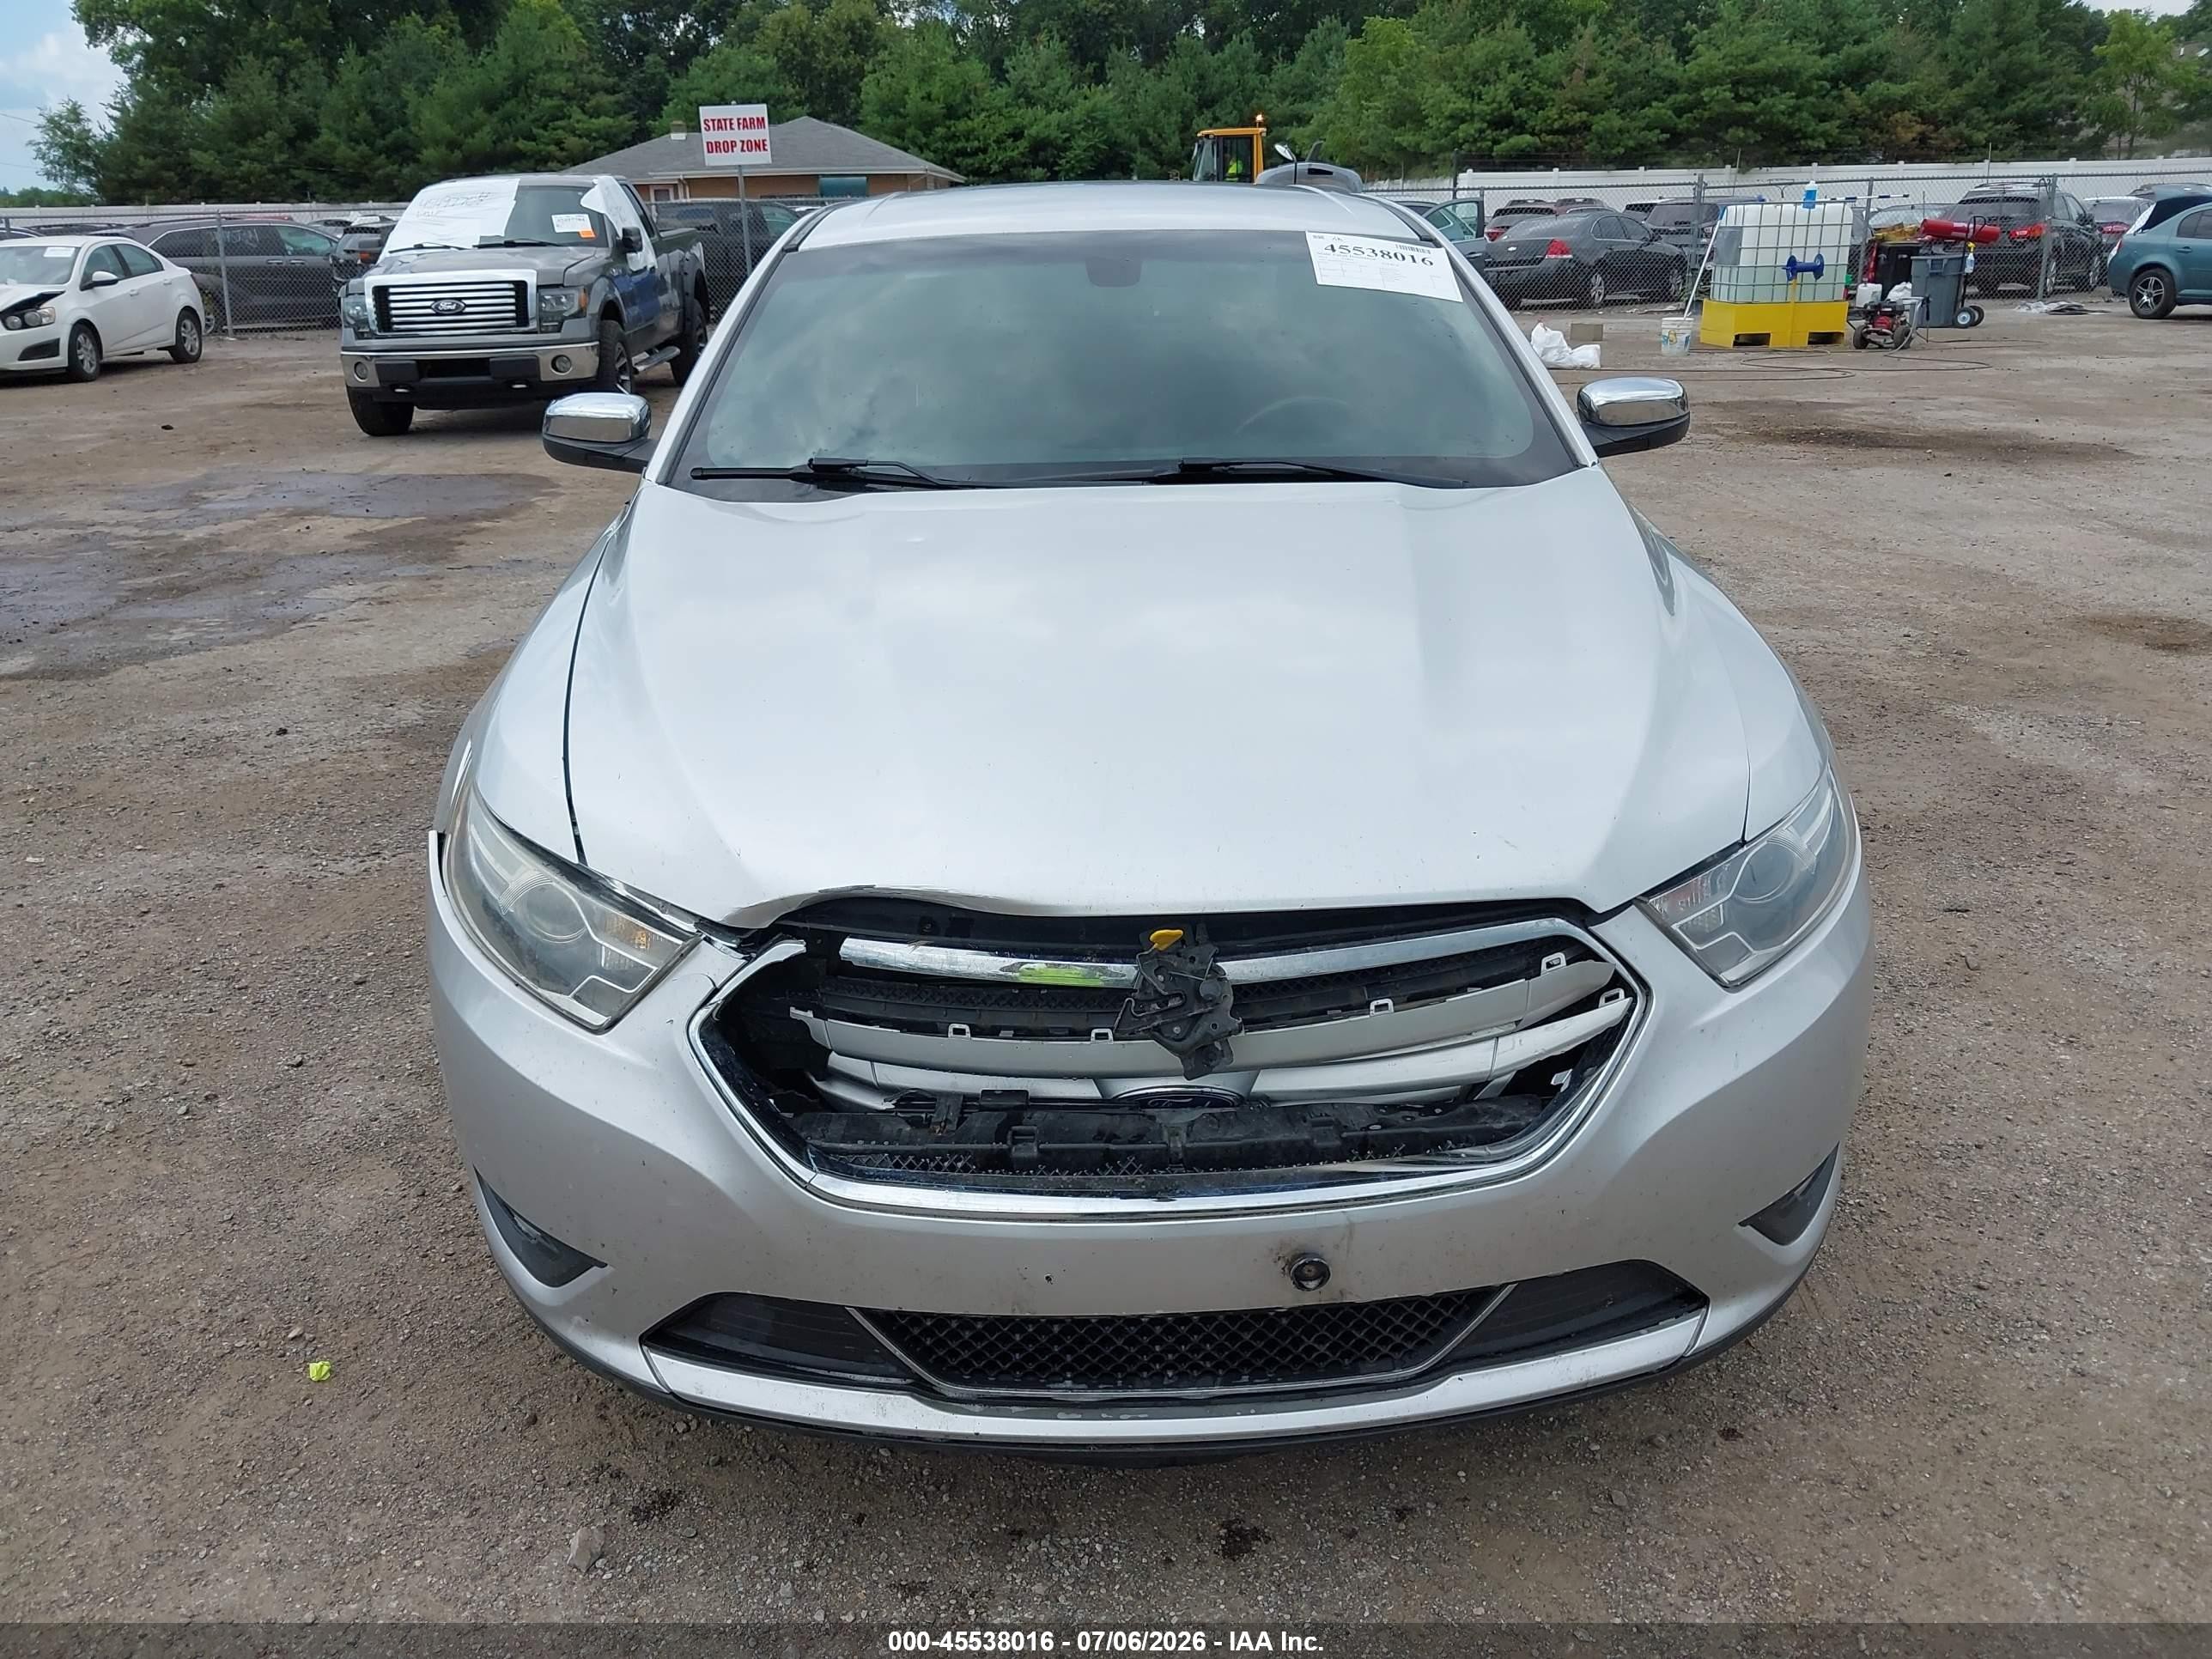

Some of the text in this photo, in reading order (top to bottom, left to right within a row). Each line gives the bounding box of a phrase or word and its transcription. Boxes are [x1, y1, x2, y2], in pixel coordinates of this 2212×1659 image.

[703, 117, 766, 131] STATE FARM
[706, 139, 769, 154] DROP ZONE
[1324, 243, 1434, 267] 45538016
